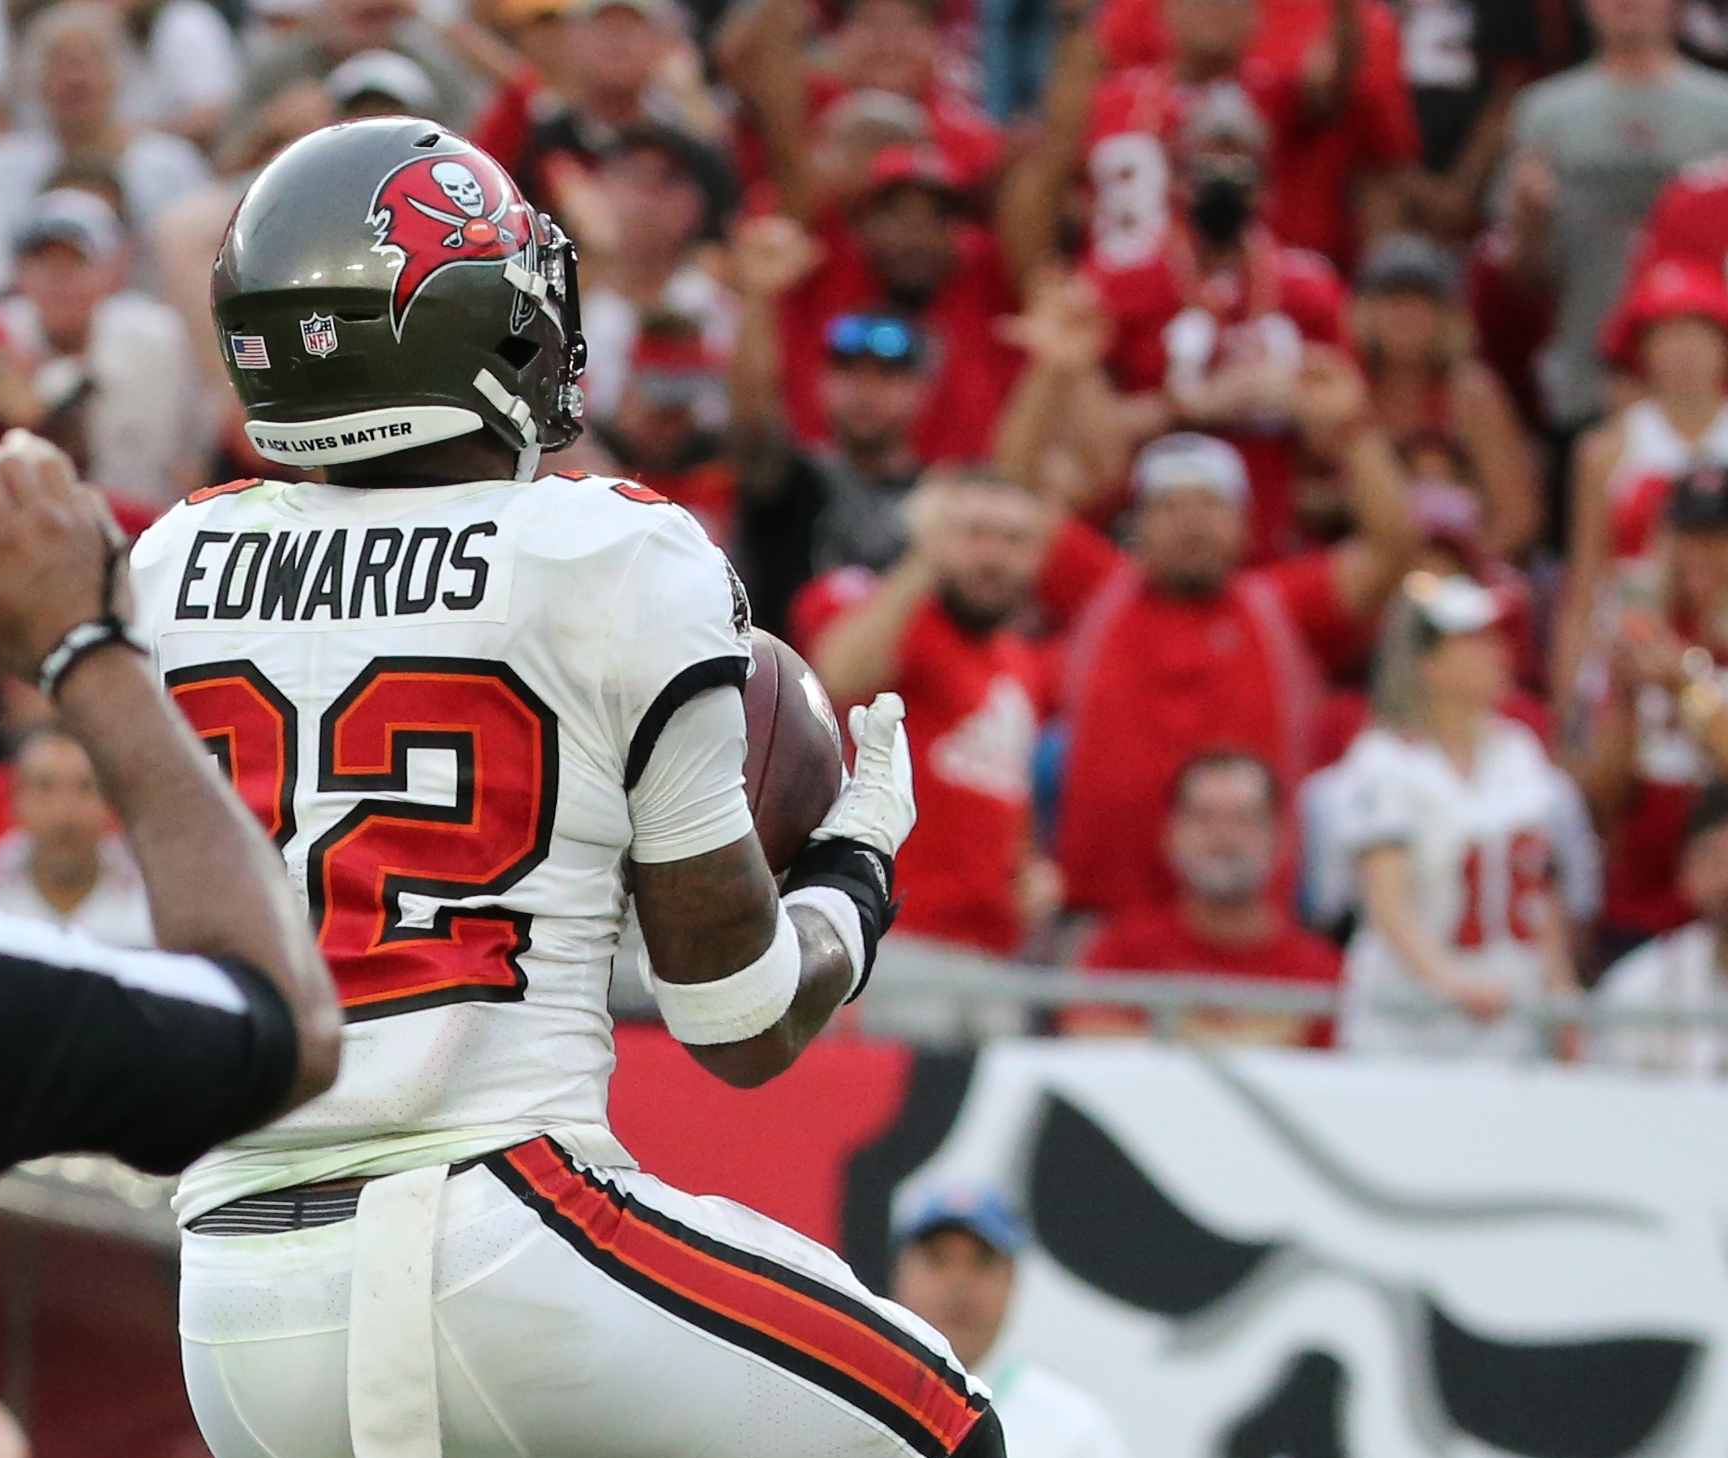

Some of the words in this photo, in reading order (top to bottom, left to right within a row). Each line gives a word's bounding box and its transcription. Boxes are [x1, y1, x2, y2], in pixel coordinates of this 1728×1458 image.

[306, 332, 333, 350] NFL
[255, 436, 290, 453] BLACK
[292, 436, 338, 453] LIVES
[341, 421, 413, 446] MATTER
[175, 520, 498, 621] EDWARDS
